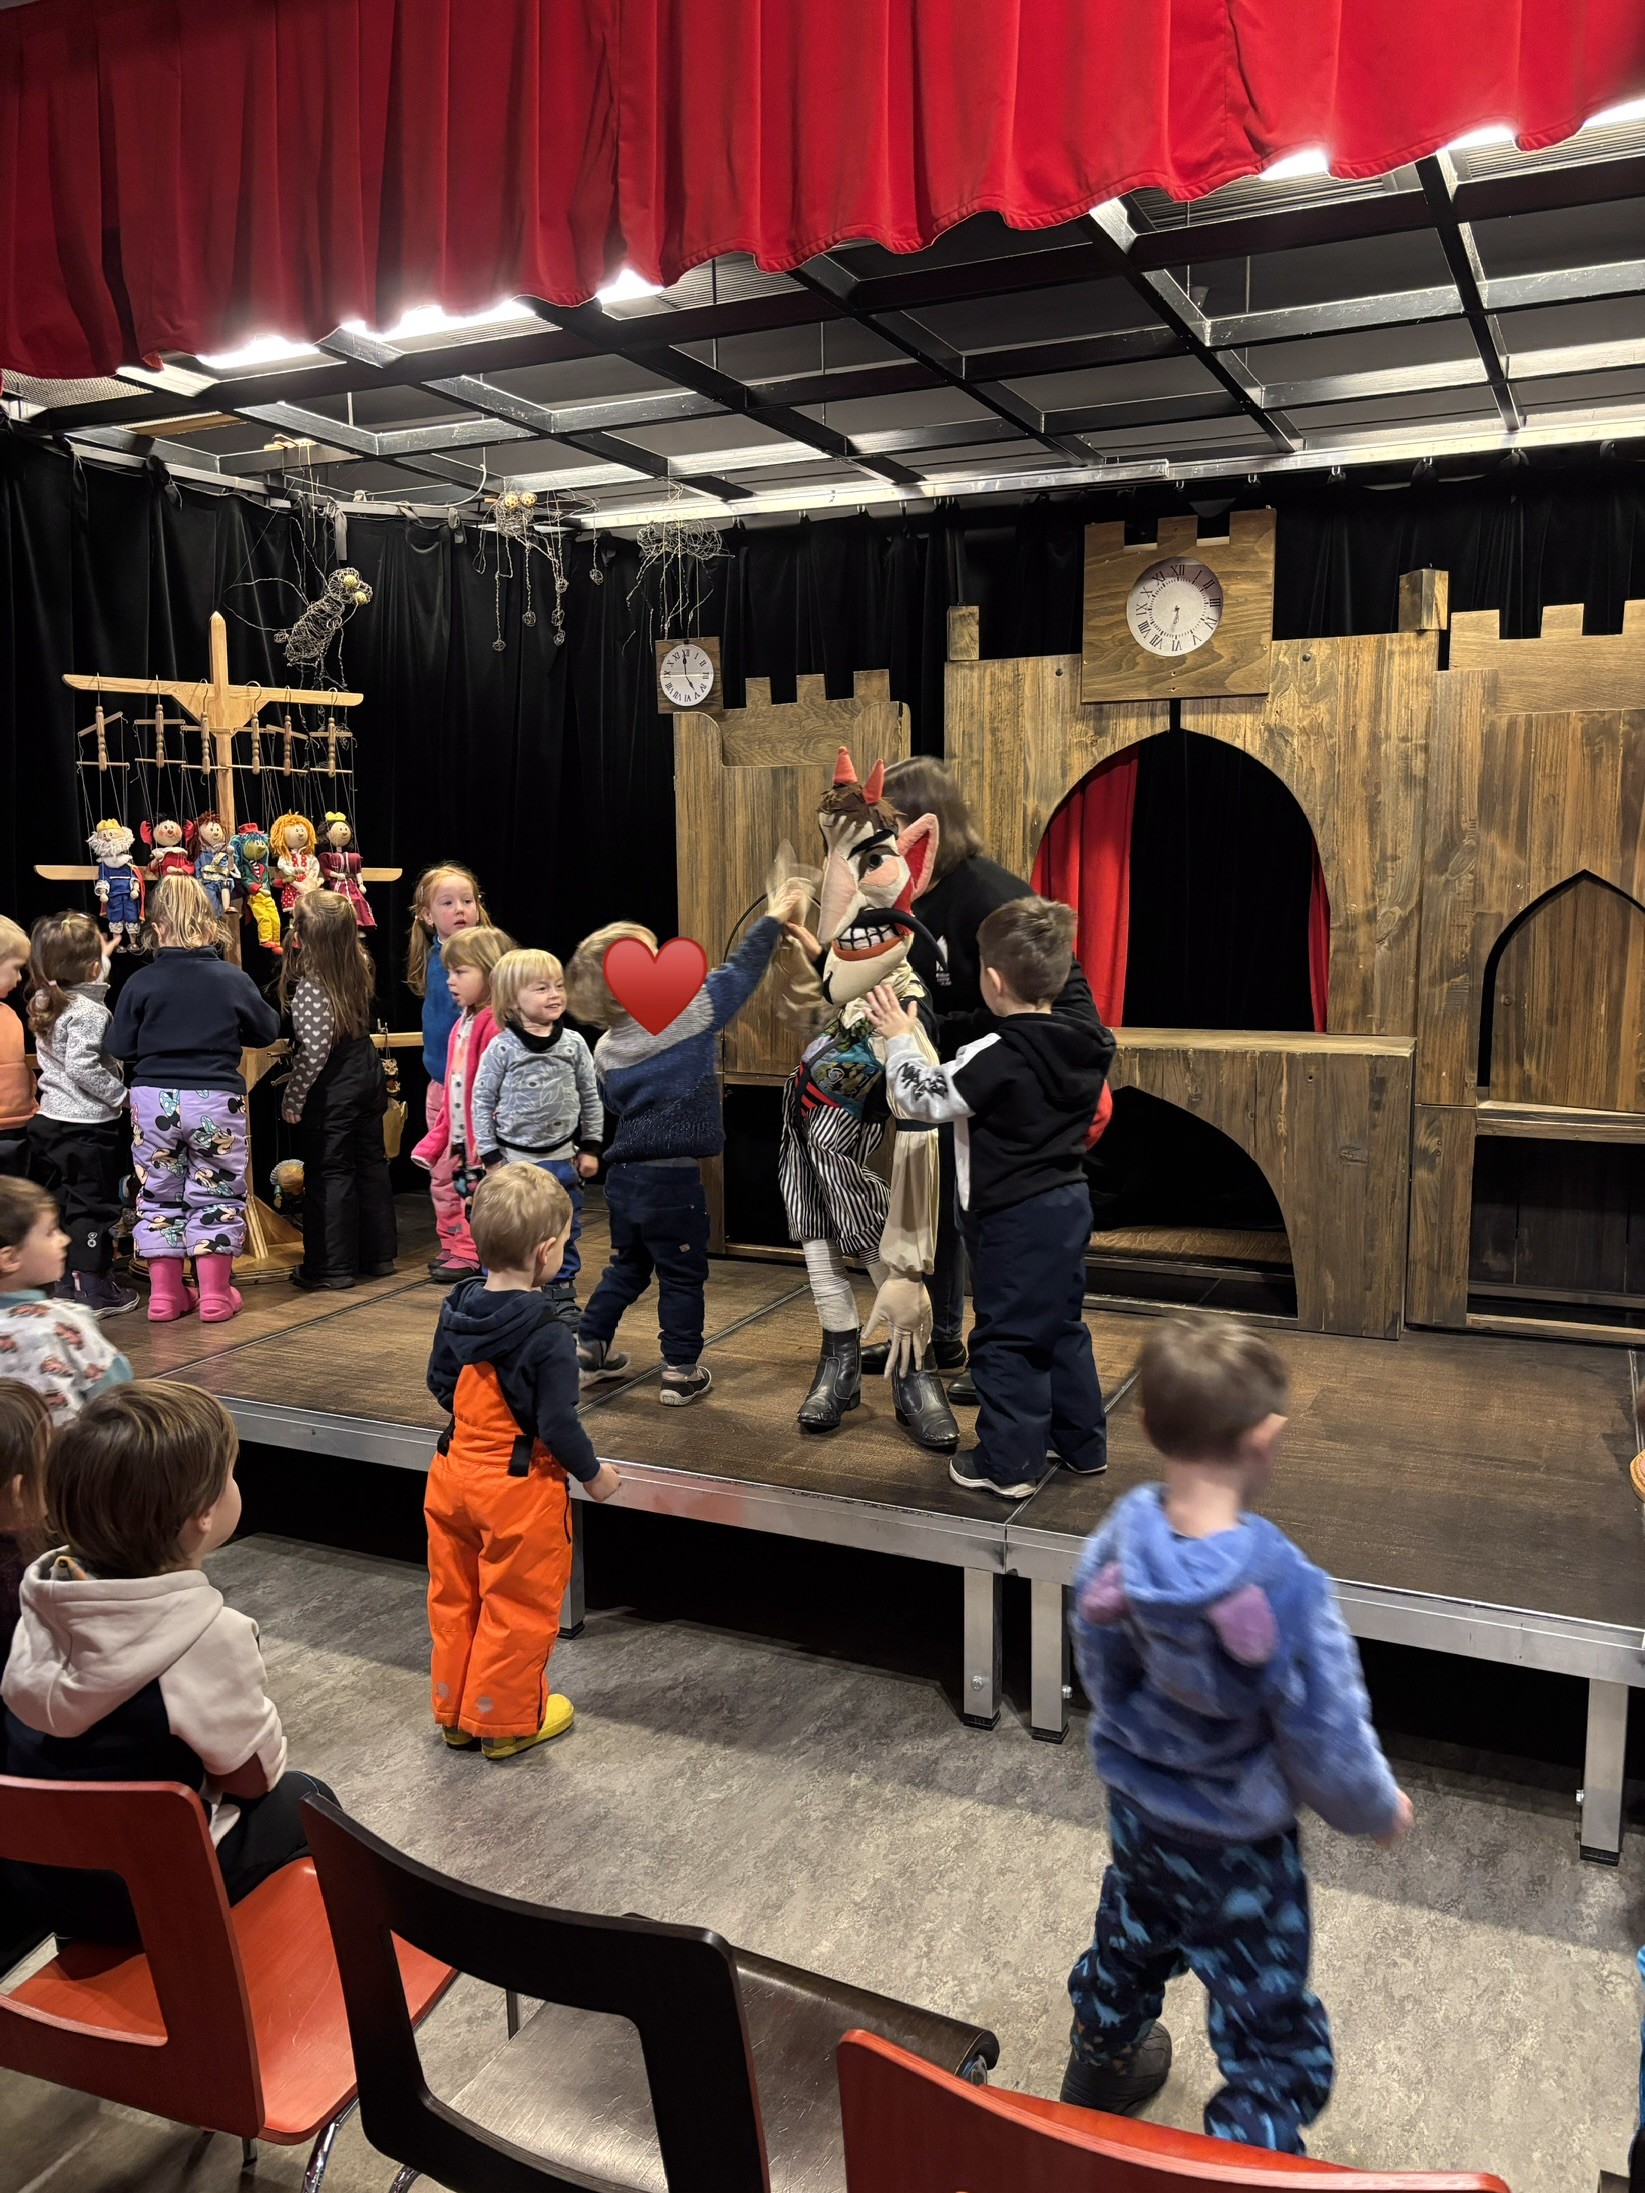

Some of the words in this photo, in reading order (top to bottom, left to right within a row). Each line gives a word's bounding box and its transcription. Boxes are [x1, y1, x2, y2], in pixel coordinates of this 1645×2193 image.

[1170, 565, 1185, 575] XII
[1194, 570, 1202, 580] I
[1152, 571, 1165, 585] XI
[1203, 579, 1215, 589] II
[1140, 587, 1152, 598] X
[1209, 598, 1221, 607] III
[1136, 603, 1148, 615] IX
[1138, 620, 1151, 638] VIII
[1204, 617, 1217, 630] IV
[1150, 634, 1163, 650] VII
[1172, 640, 1182, 651] VI
[1192, 635, 1202, 645] V
